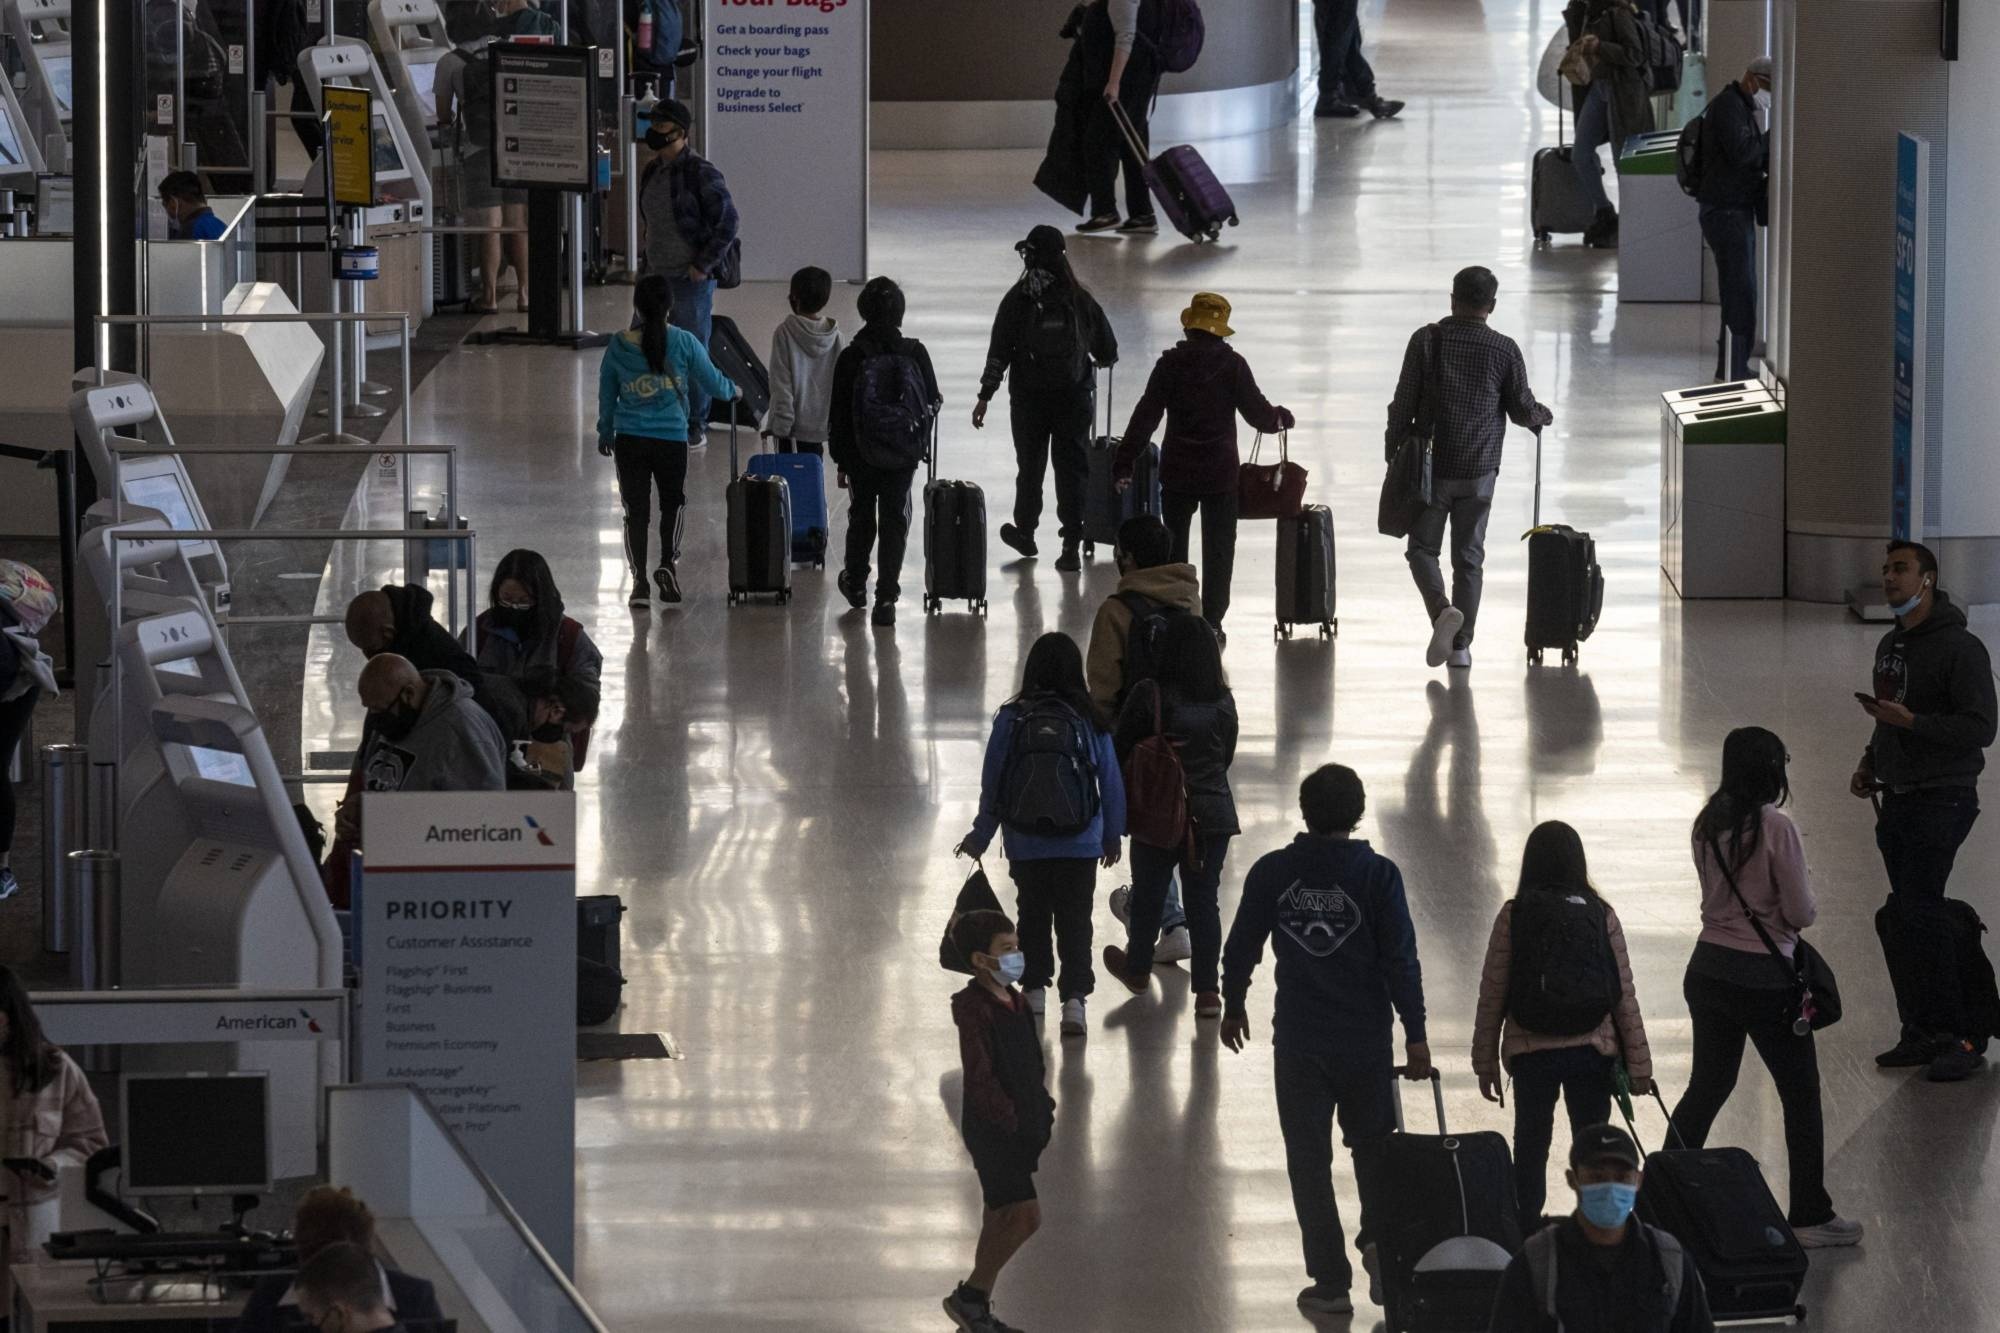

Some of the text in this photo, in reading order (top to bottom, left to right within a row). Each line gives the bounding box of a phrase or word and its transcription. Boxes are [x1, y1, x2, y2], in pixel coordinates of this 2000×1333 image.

[717, 25, 829, 37] Get a boarding pass
[717, 46, 811, 58] Check your bags
[717, 66, 823, 79] Change your flight
[717, 88, 781, 100] Upgrade to
[717, 103, 765, 113] Business
[1896, 231, 1913, 276] SFO
[425, 825, 522, 842] American
[1287, 889, 1345, 912] VANS
[387, 900, 512, 919] PRIORITY
[387, 936, 533, 950] Customer Assistance
[443, 965, 469, 976] First
[443, 984, 493, 994] Business
[386, 1003, 411, 1013] First
[216, 1015, 297, 1030] American
[386, 1022, 437, 1032] Business
[386, 1040, 498, 1052] Premium Economy
[468, 1103, 521, 1114] Platinum
